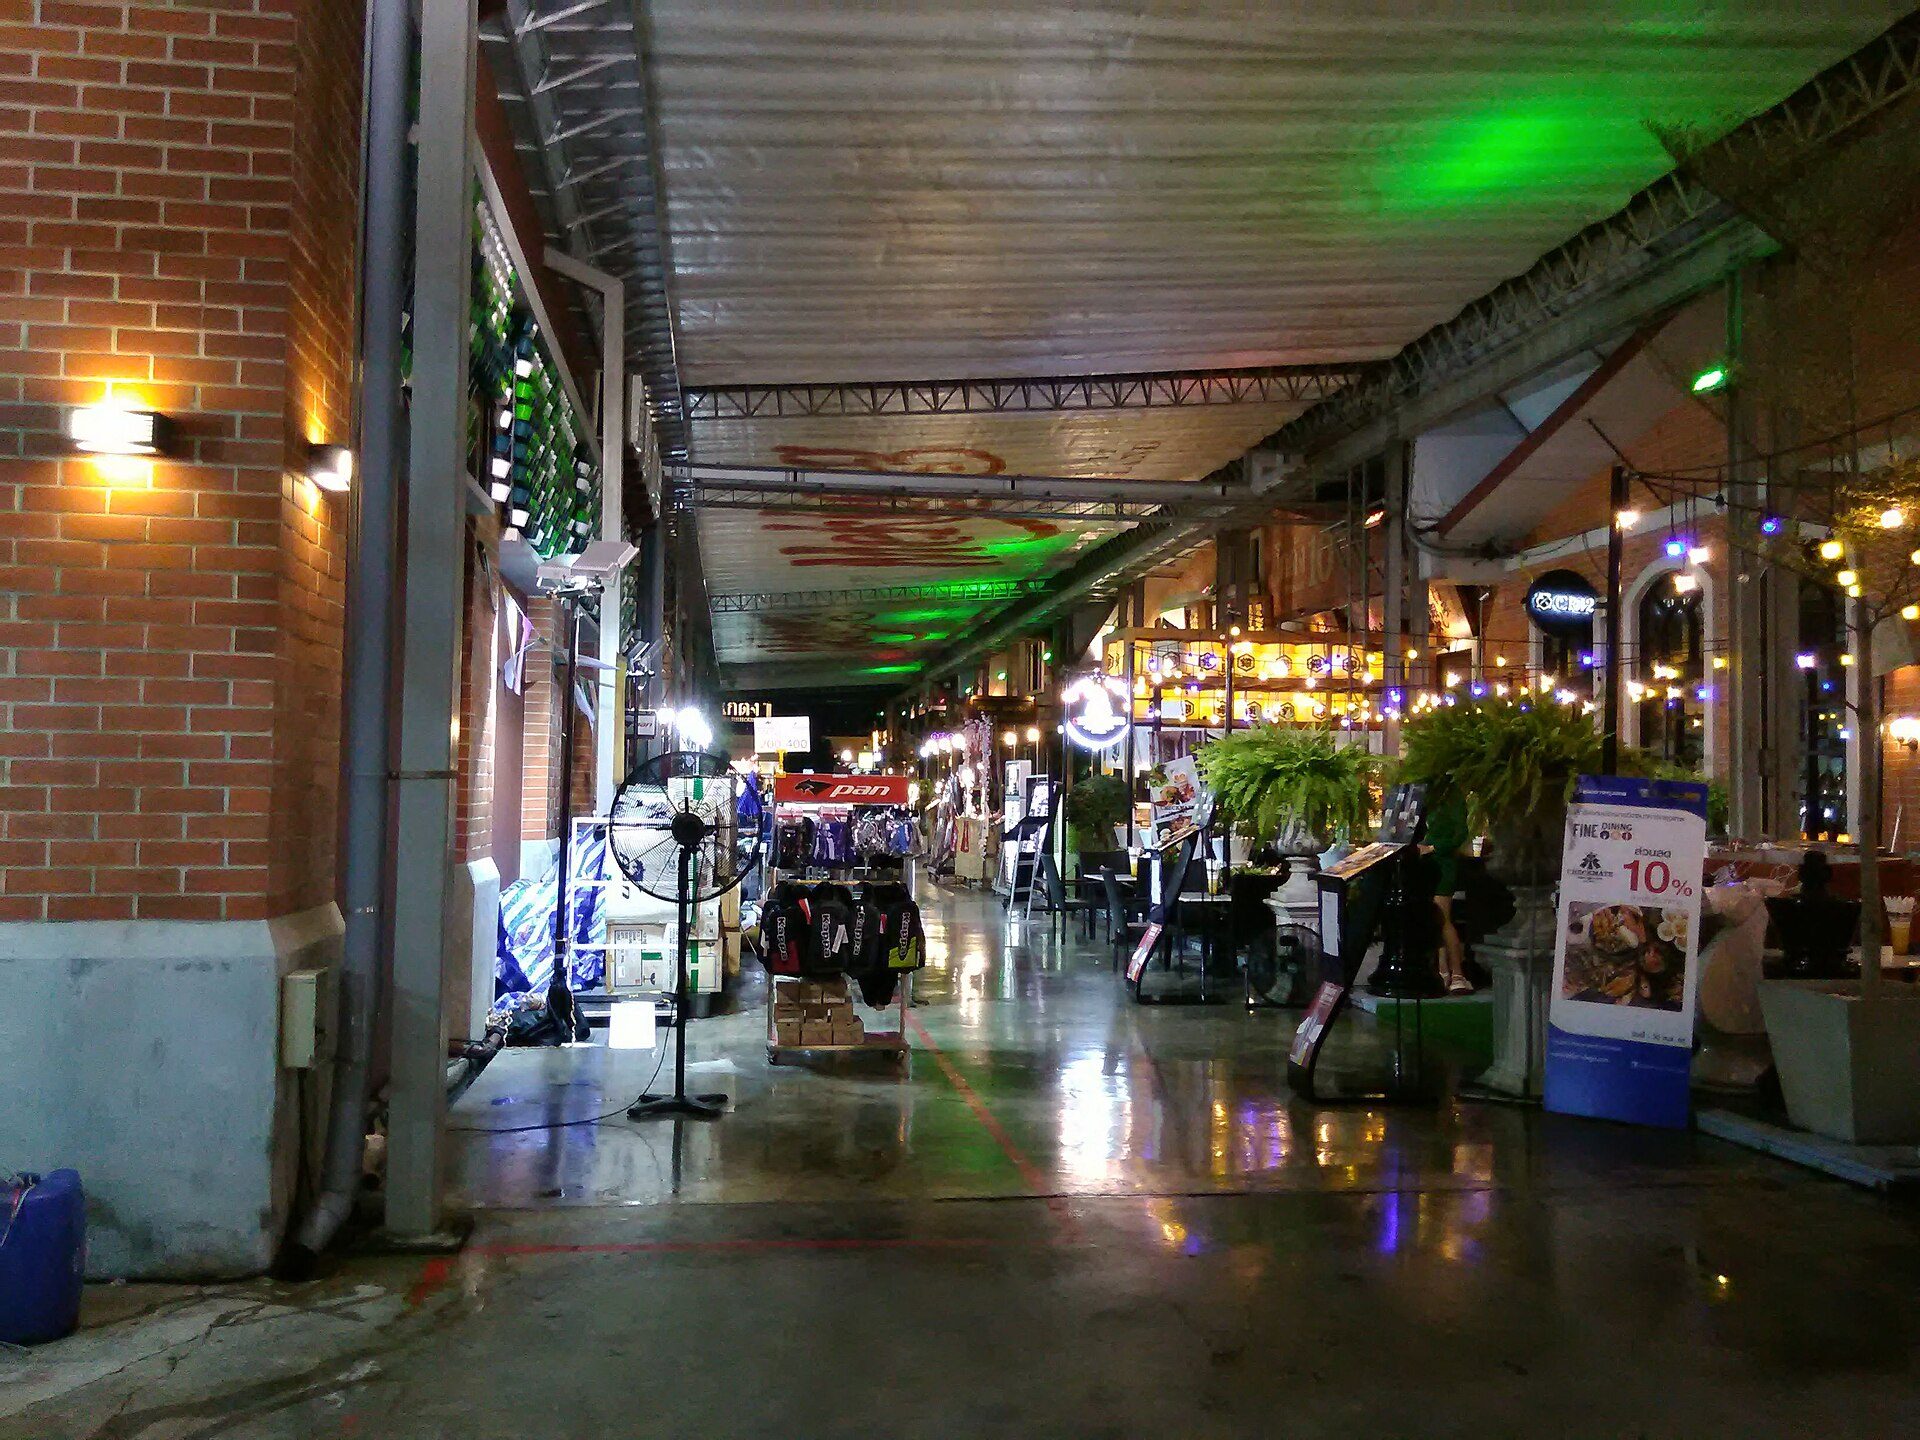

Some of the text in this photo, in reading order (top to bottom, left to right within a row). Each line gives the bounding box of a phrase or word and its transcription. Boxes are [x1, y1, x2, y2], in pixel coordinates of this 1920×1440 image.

[786, 738, 808, 749] 400
[829, 784, 890, 798] pan
[1573, 822, 1633, 838] FINE DINING
[1623, 860, 1693, 896] 10%
[776, 916, 789, 962] Kappa
[821, 913, 832, 958] Kappa
[900, 911, 911, 958] Kappa
